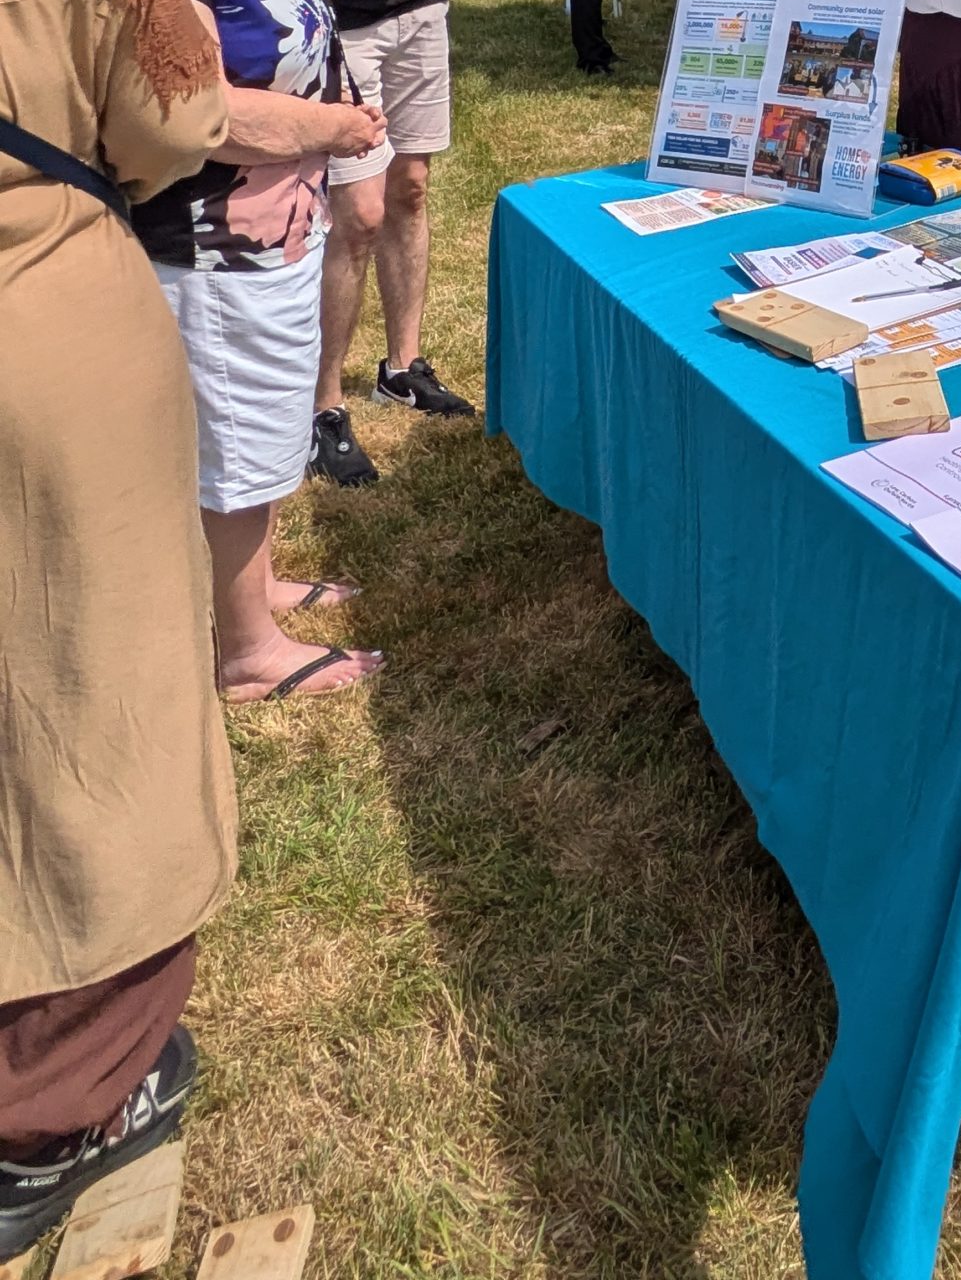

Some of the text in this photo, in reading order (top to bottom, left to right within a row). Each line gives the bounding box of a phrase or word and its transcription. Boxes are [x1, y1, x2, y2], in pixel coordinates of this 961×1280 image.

[808, 3, 885, 15] Community owned solar
[835, 146, 862, 163] HOME
[832, 161, 868, 180] ENERGY
